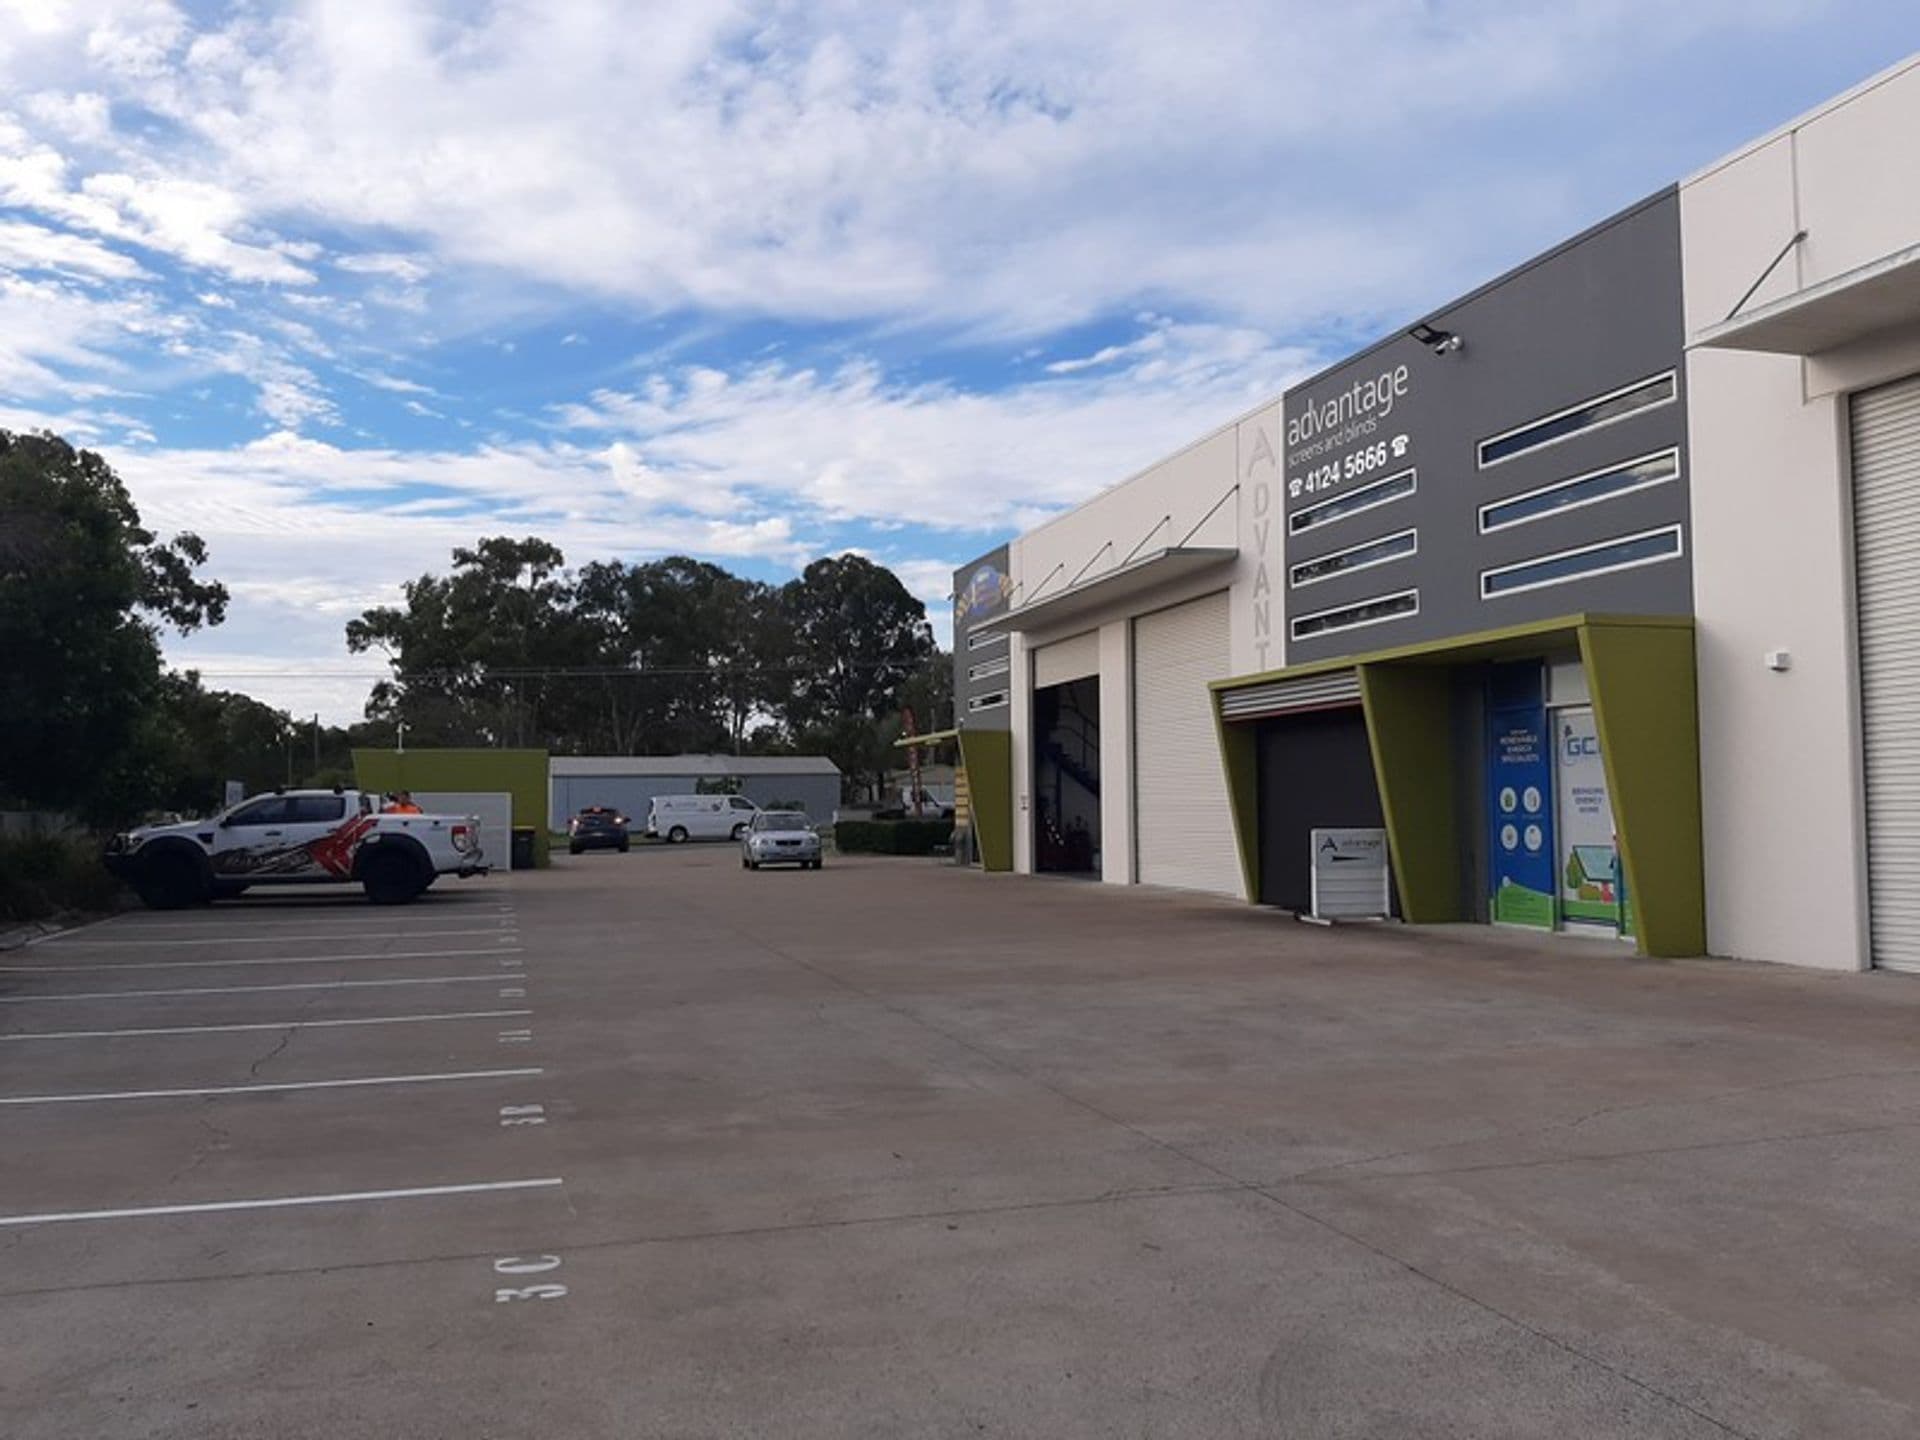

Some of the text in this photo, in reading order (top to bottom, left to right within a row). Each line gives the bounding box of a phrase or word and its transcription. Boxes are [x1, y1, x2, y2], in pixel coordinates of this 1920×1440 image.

[1288, 365, 1408, 446] advantage
[1288, 412, 1377, 468] screens and blinds
[1305, 440, 1387, 493] 4124 5666
[1567, 736, 1602, 756] GC
